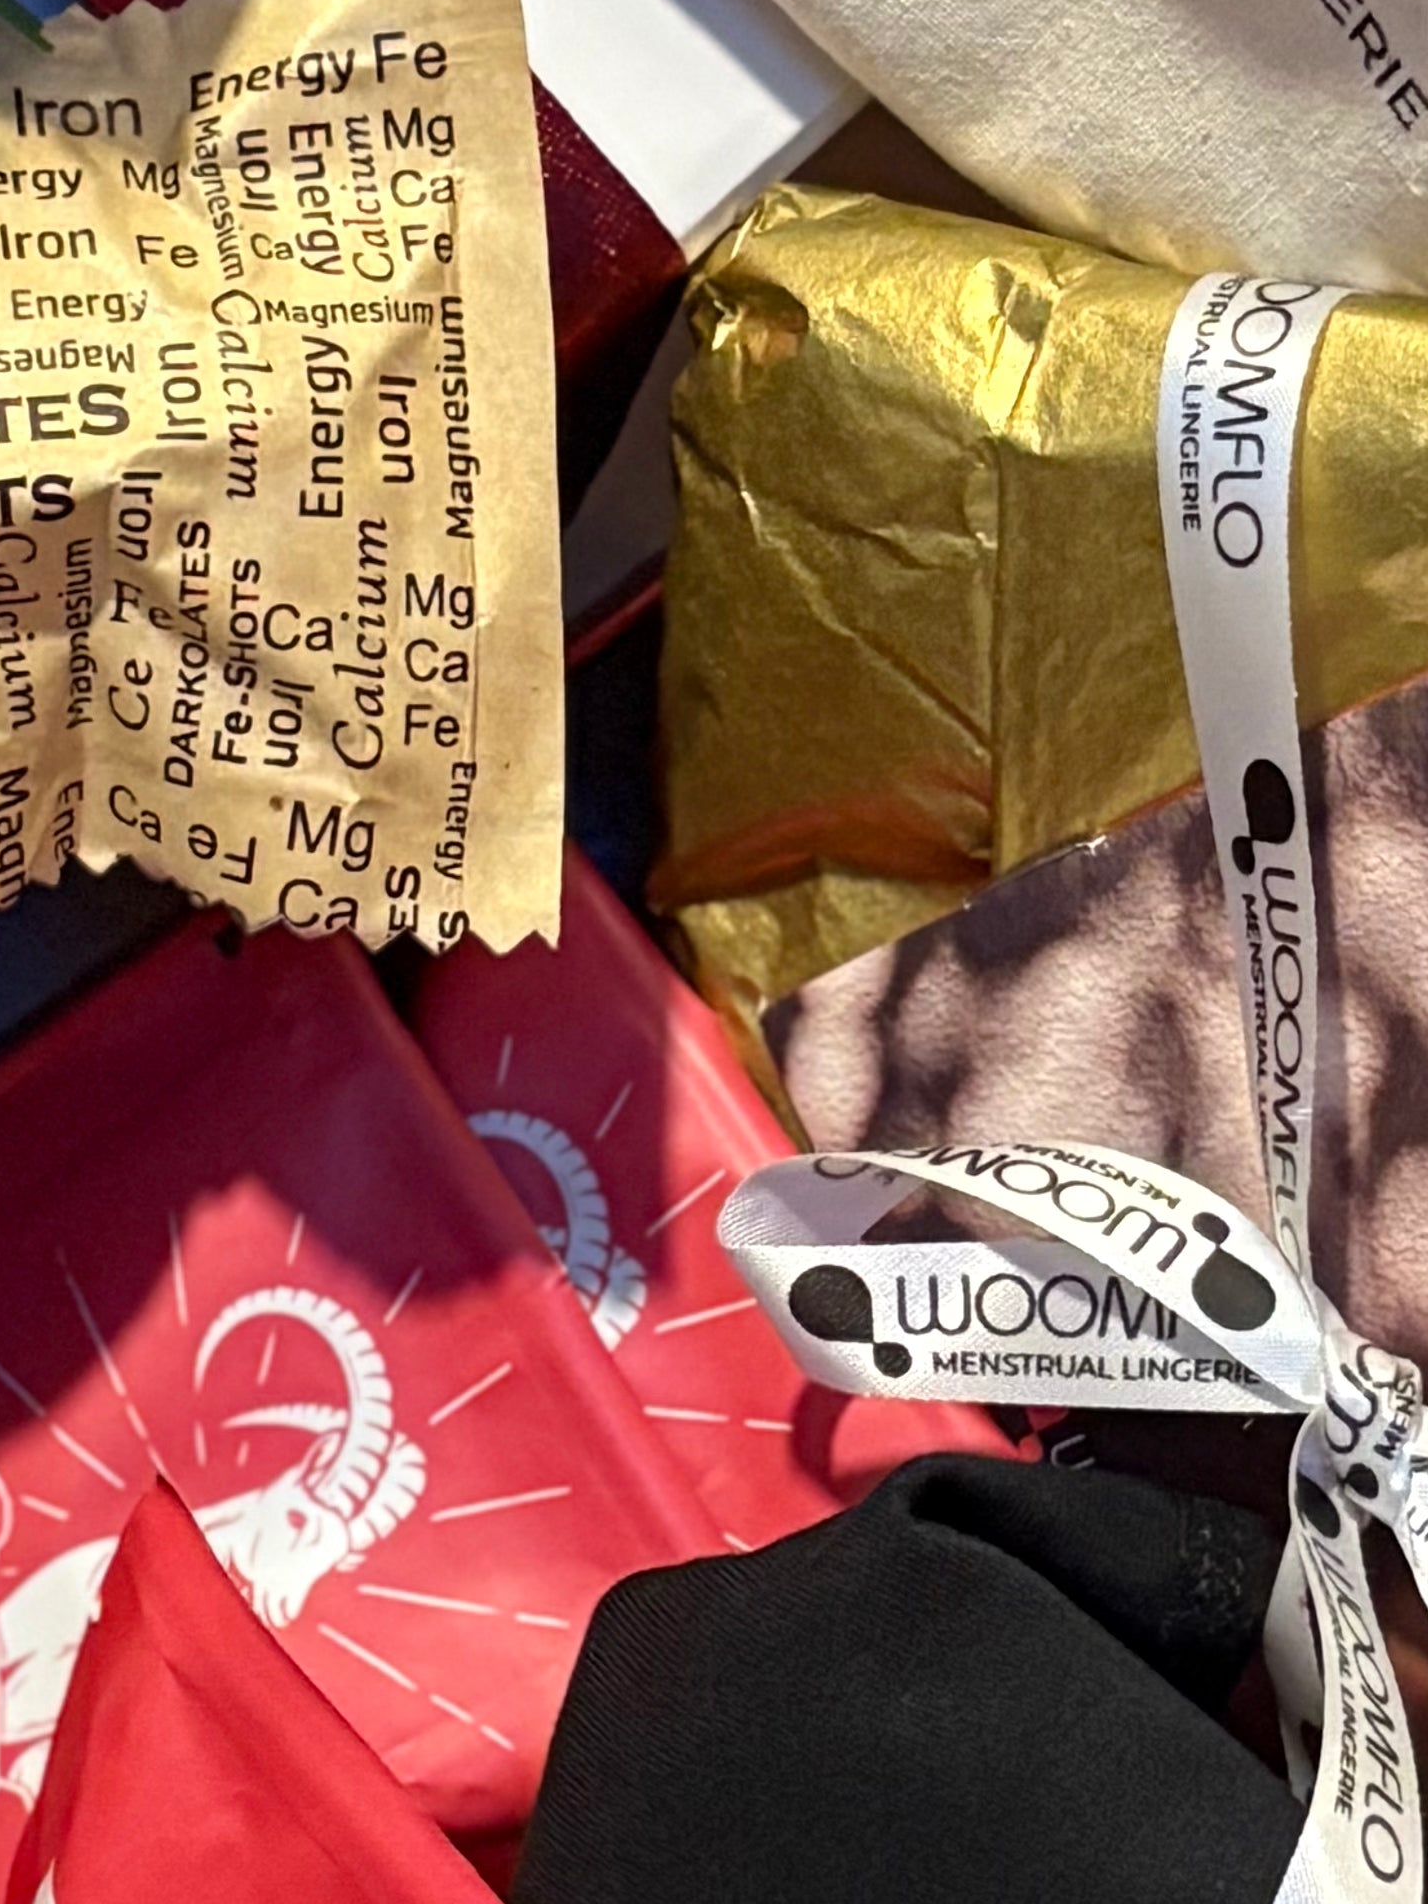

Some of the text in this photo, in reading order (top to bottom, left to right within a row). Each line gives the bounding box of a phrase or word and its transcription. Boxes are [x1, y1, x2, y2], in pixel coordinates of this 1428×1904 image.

[190, 48, 355, 111] Energy
[373, 31, 447, 83] Fe
[13, 86, 142, 137] Iron
[383, 107, 455, 157] Mg
[123, 159, 181, 200] Mg
[191, 116, 244, 280] Magnesium
[236, 128, 278, 212] Iron
[288, 122, 345, 276] Energy
[341, 114, 395, 283] Calcium
[390, 169, 455, 208] Ca
[0, 224, 97, 261] Iron
[136, 234, 199, 269] Fe
[250, 232, 294, 261] Ca
[401, 224, 454, 264] Fe
[11, 289, 148, 323] Energy
[264, 296, 433, 329] Magnesium
[155, 342, 208, 441] Iron
[211, 288, 274, 500] Calcium
[434, 296, 481, 539] Magnesium
[299, 335, 352, 518] Energy
[379, 374, 417, 484] Iron
[1213, 281, 1322, 569] OOMFLO
[1179, 384, 1204, 533] LINGERIE
[118, 471, 162, 561] Iron
[58, 537, 97, 729] Magnesium
[110, 579, 174, 631] Fe
[263, 603, 333, 651] Ca
[405, 573, 475, 629] Mg
[164, 520, 210, 787] DARKOLATES
[212, 558, 262, 765] Fe-SHOTS
[332, 517, 388, 770] Calcium
[404, 639, 469, 682] Ca
[264, 679, 315, 768] Iron
[404, 703, 460, 747] Fe
[109, 785, 161, 843] Ca
[286, 800, 376, 872] Mg
[433, 761, 477, 881] Energy
[187, 824, 257, 885] Fe
[896, 1274, 1178, 1339] WOOM
[933, 1351, 1262, 1384] MENSTRUAL LINGERIE
[1334, 1685, 1362, 1823] LINGERIE
